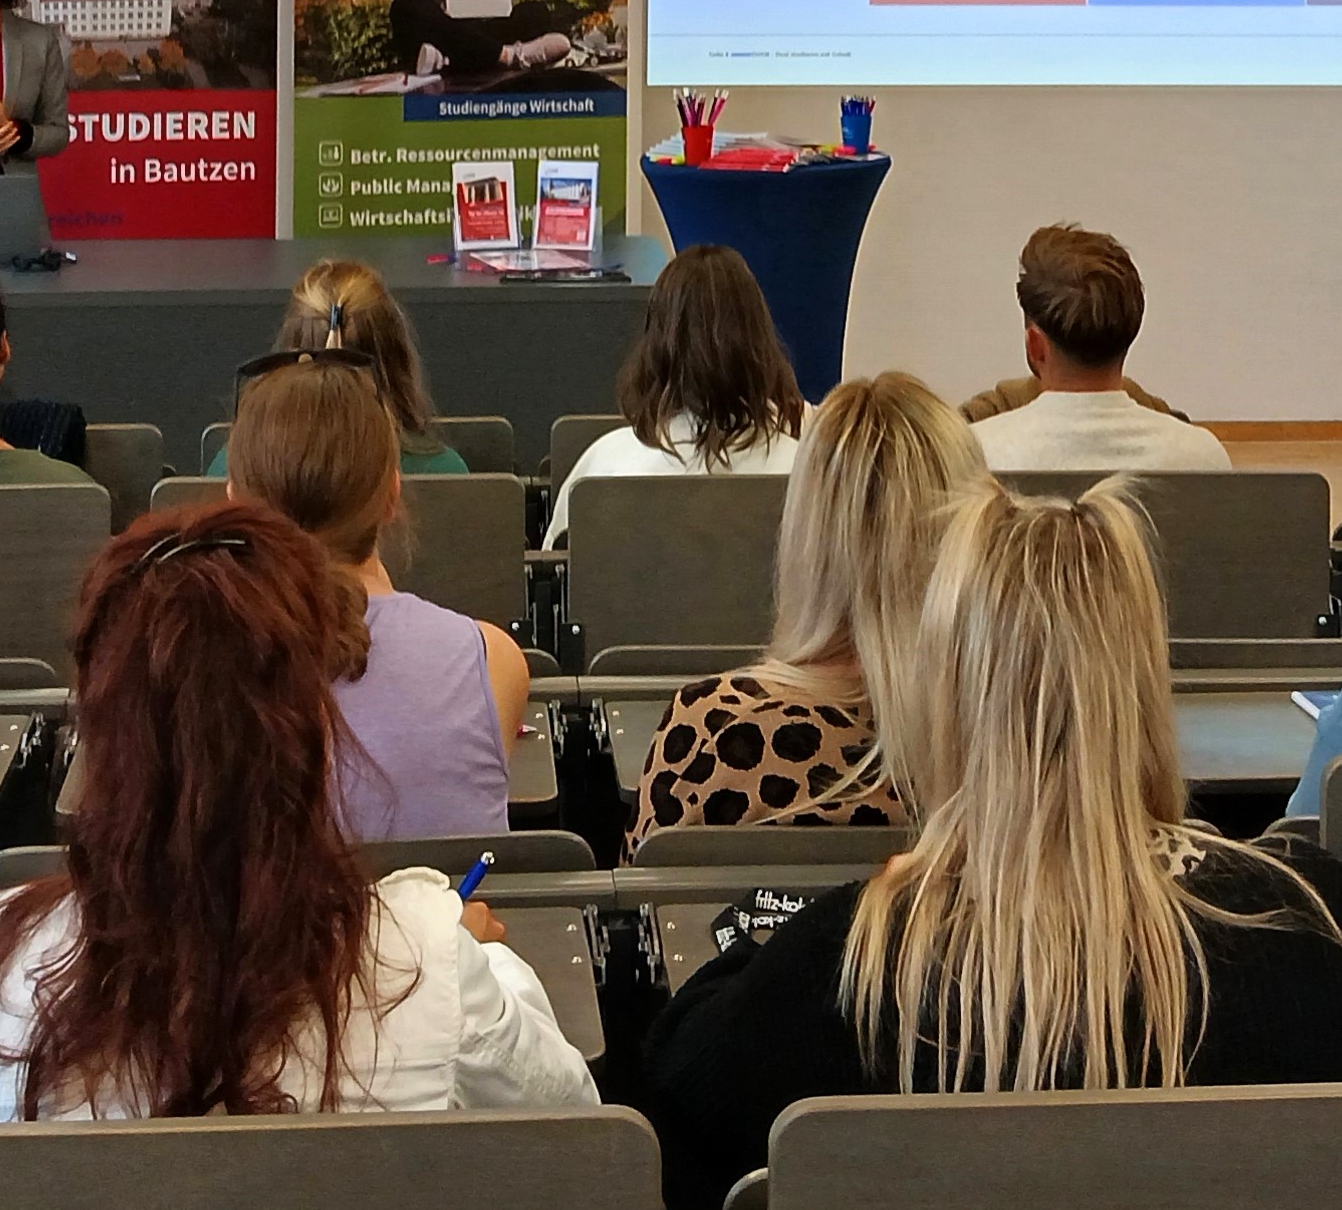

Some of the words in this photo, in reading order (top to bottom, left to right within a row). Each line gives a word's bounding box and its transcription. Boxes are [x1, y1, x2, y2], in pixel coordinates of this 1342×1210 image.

[439, 100, 527, 117] Studiengänge
[529, 97, 594, 113] Wirtschaft
[351, 147, 392, 165] Betr.
[396, 143, 600, 164] Ressourcenmanagement
[110, 157, 135, 184] in
[145, 157, 256, 183] Bautzen
[350, 178, 402, 196] Public
[755, 889, 806, 913] fritz-kol
